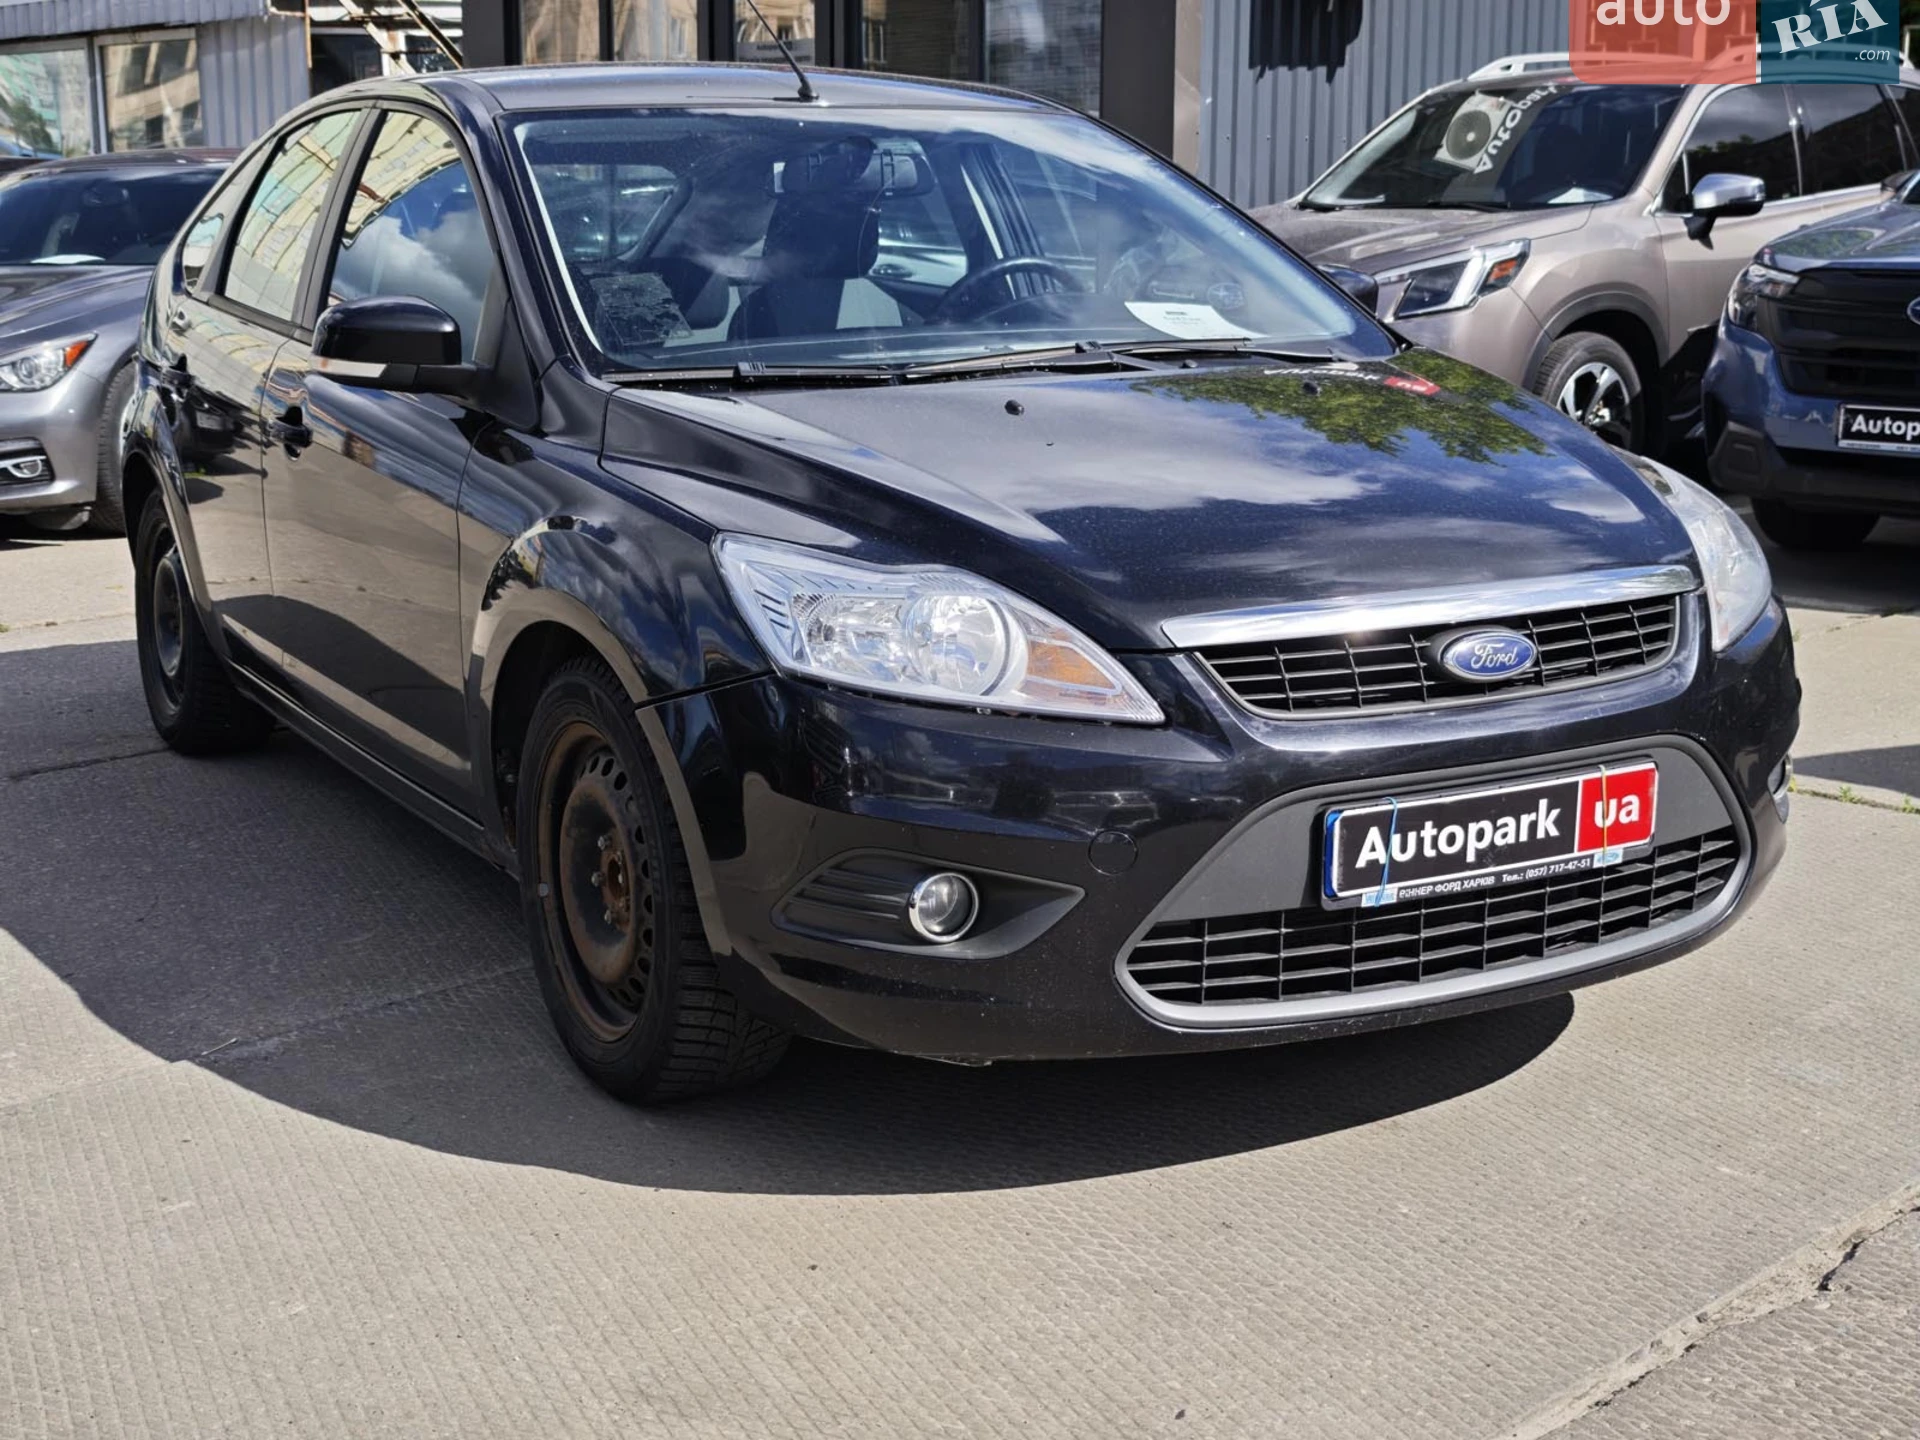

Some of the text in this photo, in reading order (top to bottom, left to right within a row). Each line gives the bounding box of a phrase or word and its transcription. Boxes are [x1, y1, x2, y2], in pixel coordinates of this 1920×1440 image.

[1470, 642, 1519, 669] Ford
[1355, 794, 1640, 868] Autopark ua
[1525, 866, 1548, 880] (057)
[1548, 858, 1591, 874] 717-47-51
